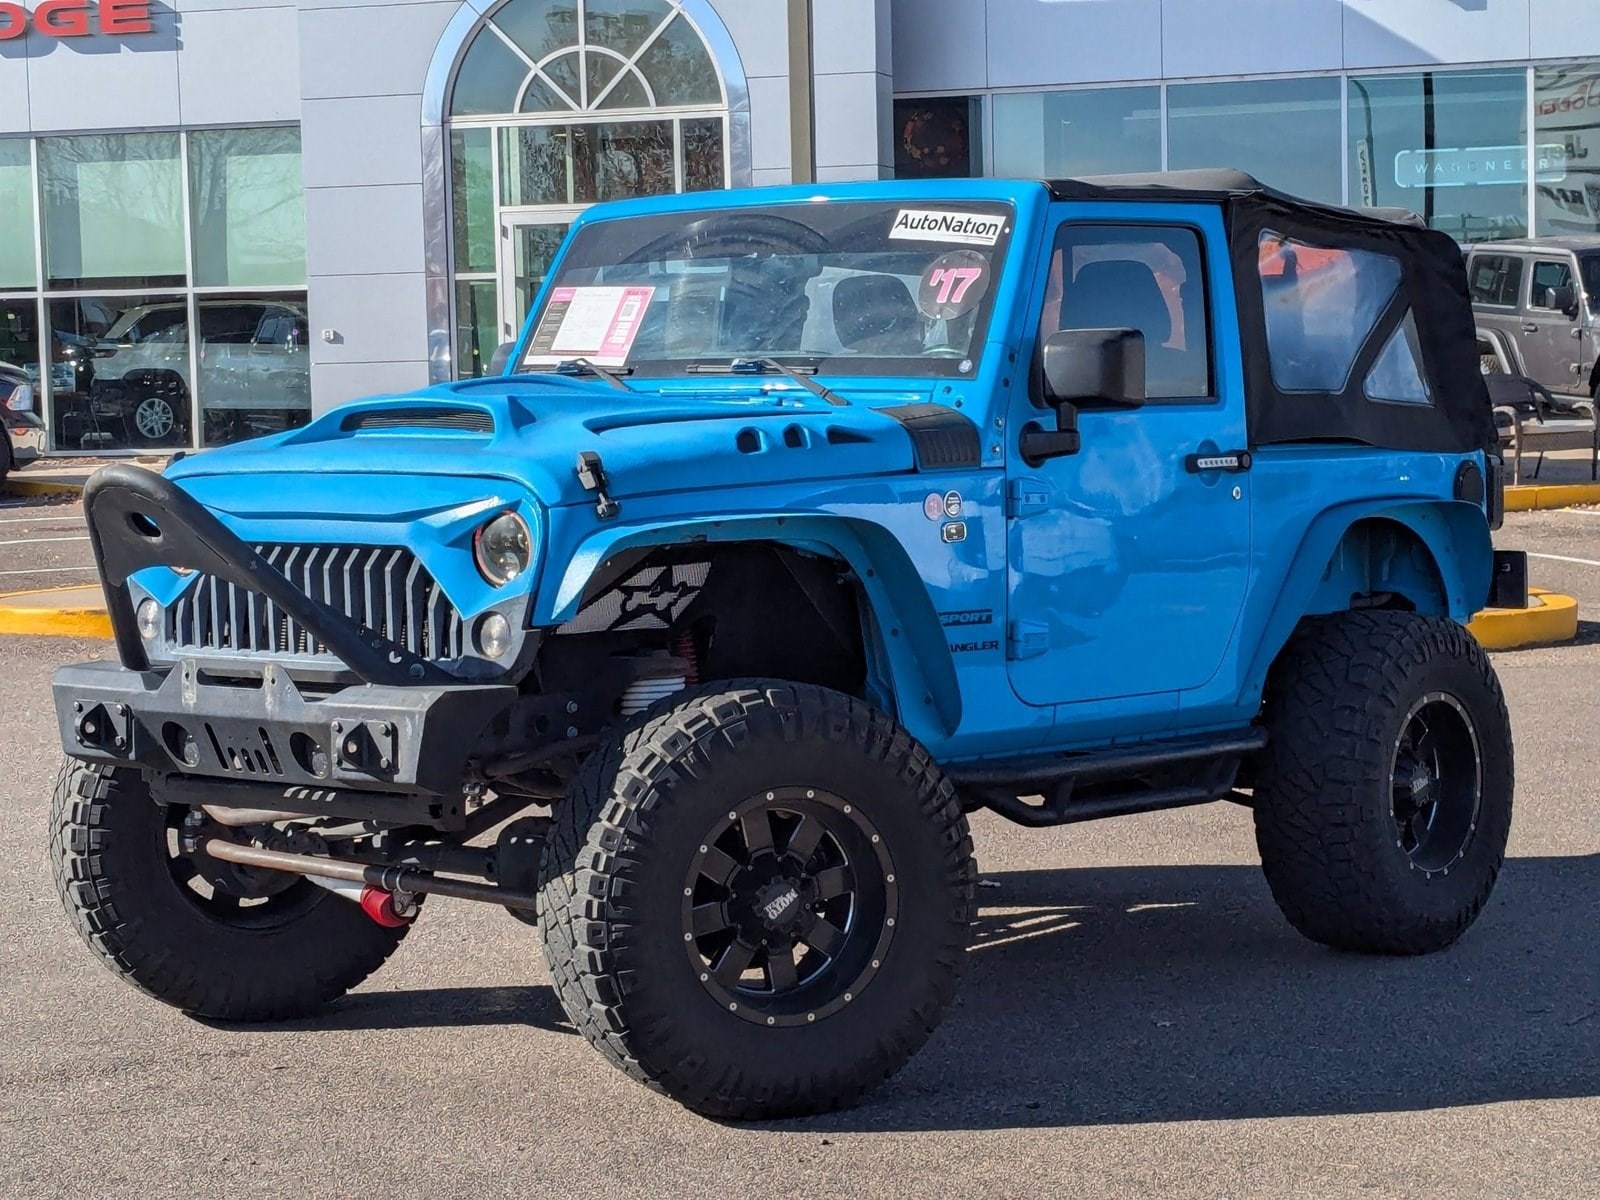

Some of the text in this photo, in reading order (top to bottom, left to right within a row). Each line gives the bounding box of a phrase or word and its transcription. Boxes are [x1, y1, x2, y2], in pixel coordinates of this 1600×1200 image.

[895, 213, 999, 236] AutoNation
[929, 267, 982, 304] '17
[940, 612, 989, 624] SPORT
